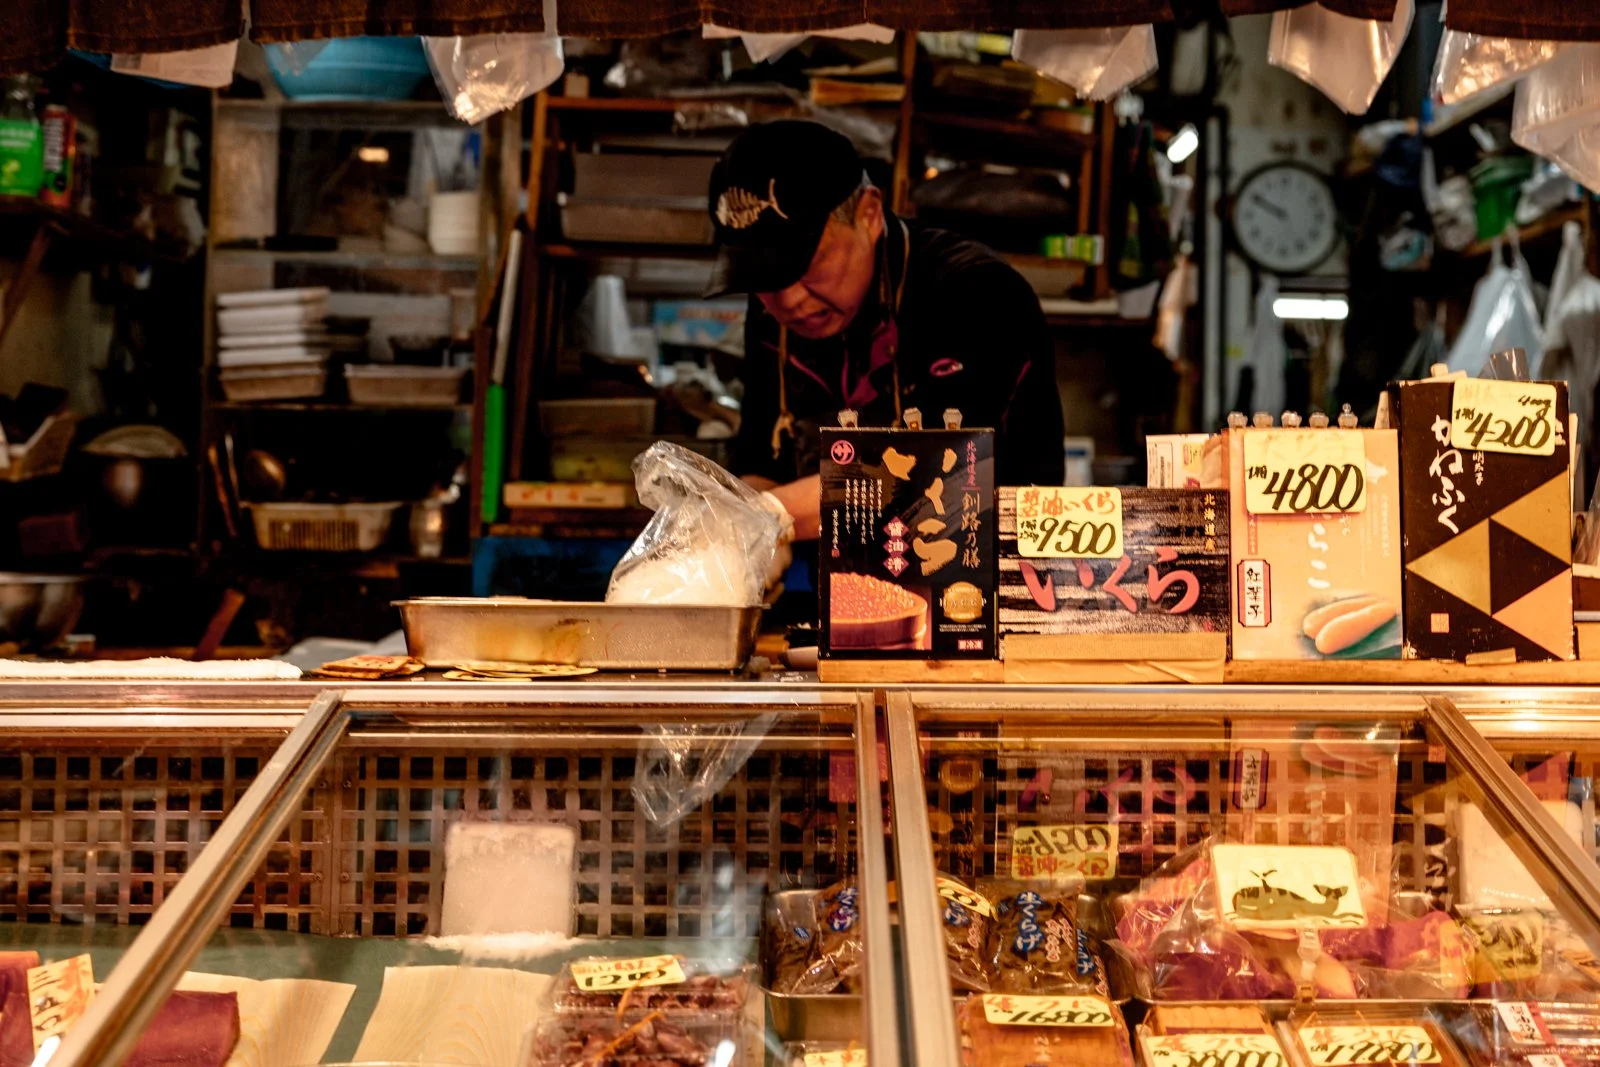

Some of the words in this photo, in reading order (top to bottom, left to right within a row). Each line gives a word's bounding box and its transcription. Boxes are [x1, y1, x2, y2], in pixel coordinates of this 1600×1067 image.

[1464, 407, 1551, 449] 4200
[1262, 463, 1364, 512] 4800
[1036, 517, 1116, 555] 9500
[1203, 493, 1216, 552] 北海道産
[1018, 546, 1200, 614] いくら
[1016, 891, 1045, 951] 生くらげ
